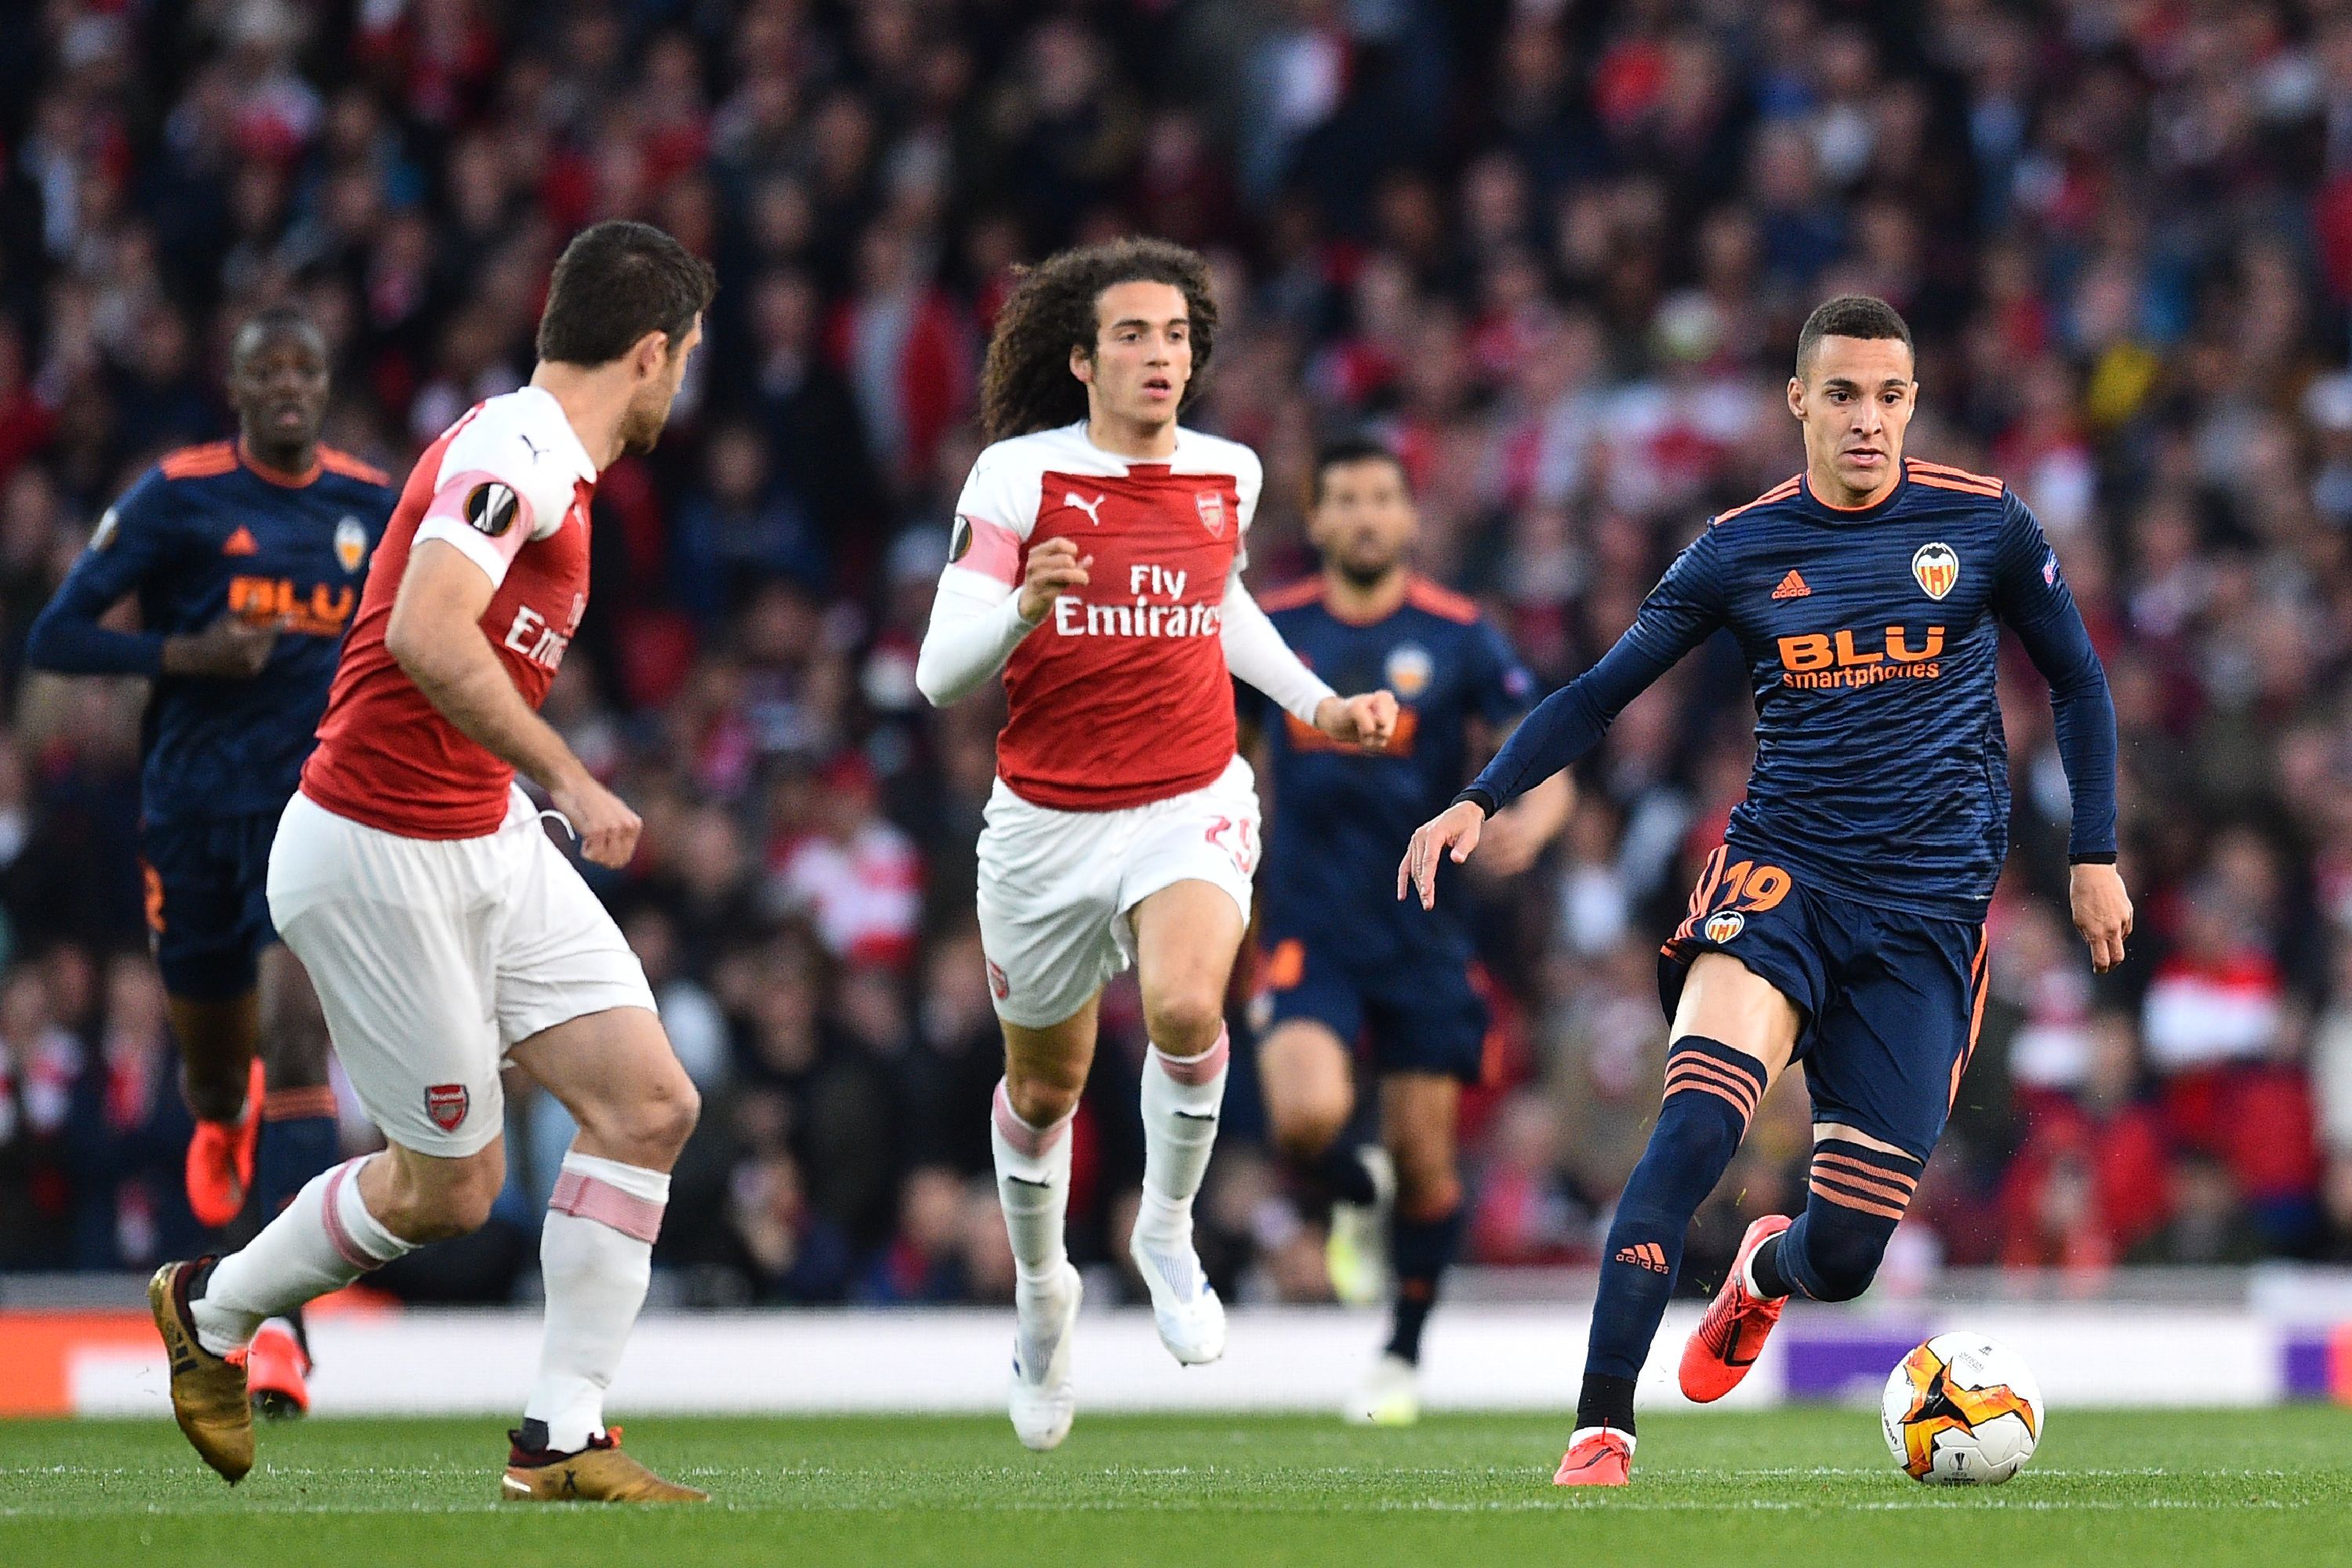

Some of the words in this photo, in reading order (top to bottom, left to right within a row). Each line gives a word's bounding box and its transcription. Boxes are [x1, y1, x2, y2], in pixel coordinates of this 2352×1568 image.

[1131, 564, 1188, 601] Fly
[1771, 586, 1812, 600] adidas
[1777, 626, 1945, 672] BLU
[1782, 663, 1940, 689] smartphones
[1721, 860, 1792, 912] 19
[1615, 1253, 1670, 1276] adidas
